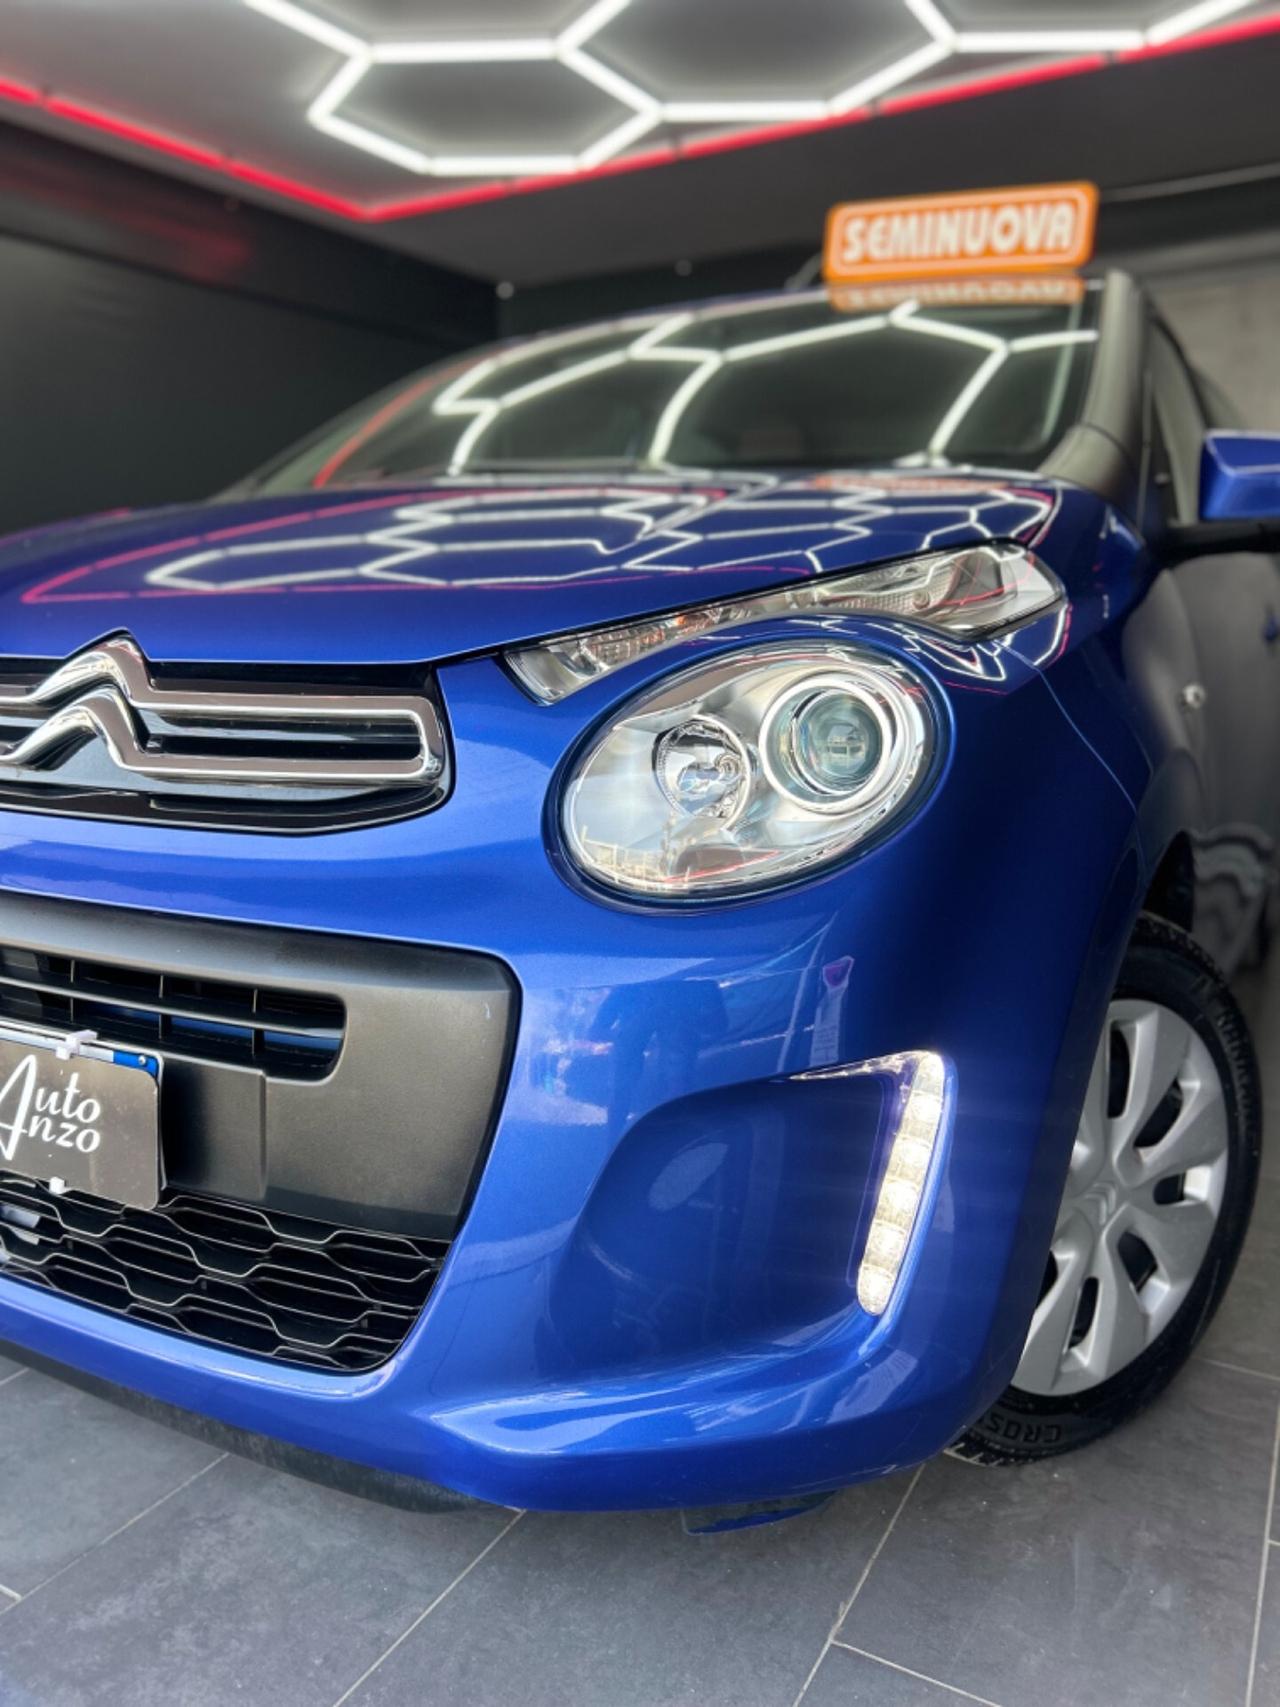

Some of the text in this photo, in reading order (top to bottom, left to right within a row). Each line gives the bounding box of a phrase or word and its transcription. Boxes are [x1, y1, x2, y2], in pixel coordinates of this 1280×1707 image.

[842, 203, 1074, 263] SEMINUOVA
[0, 1054, 101, 1160] Auto
[977, 1413, 1062, 1443] CROS
